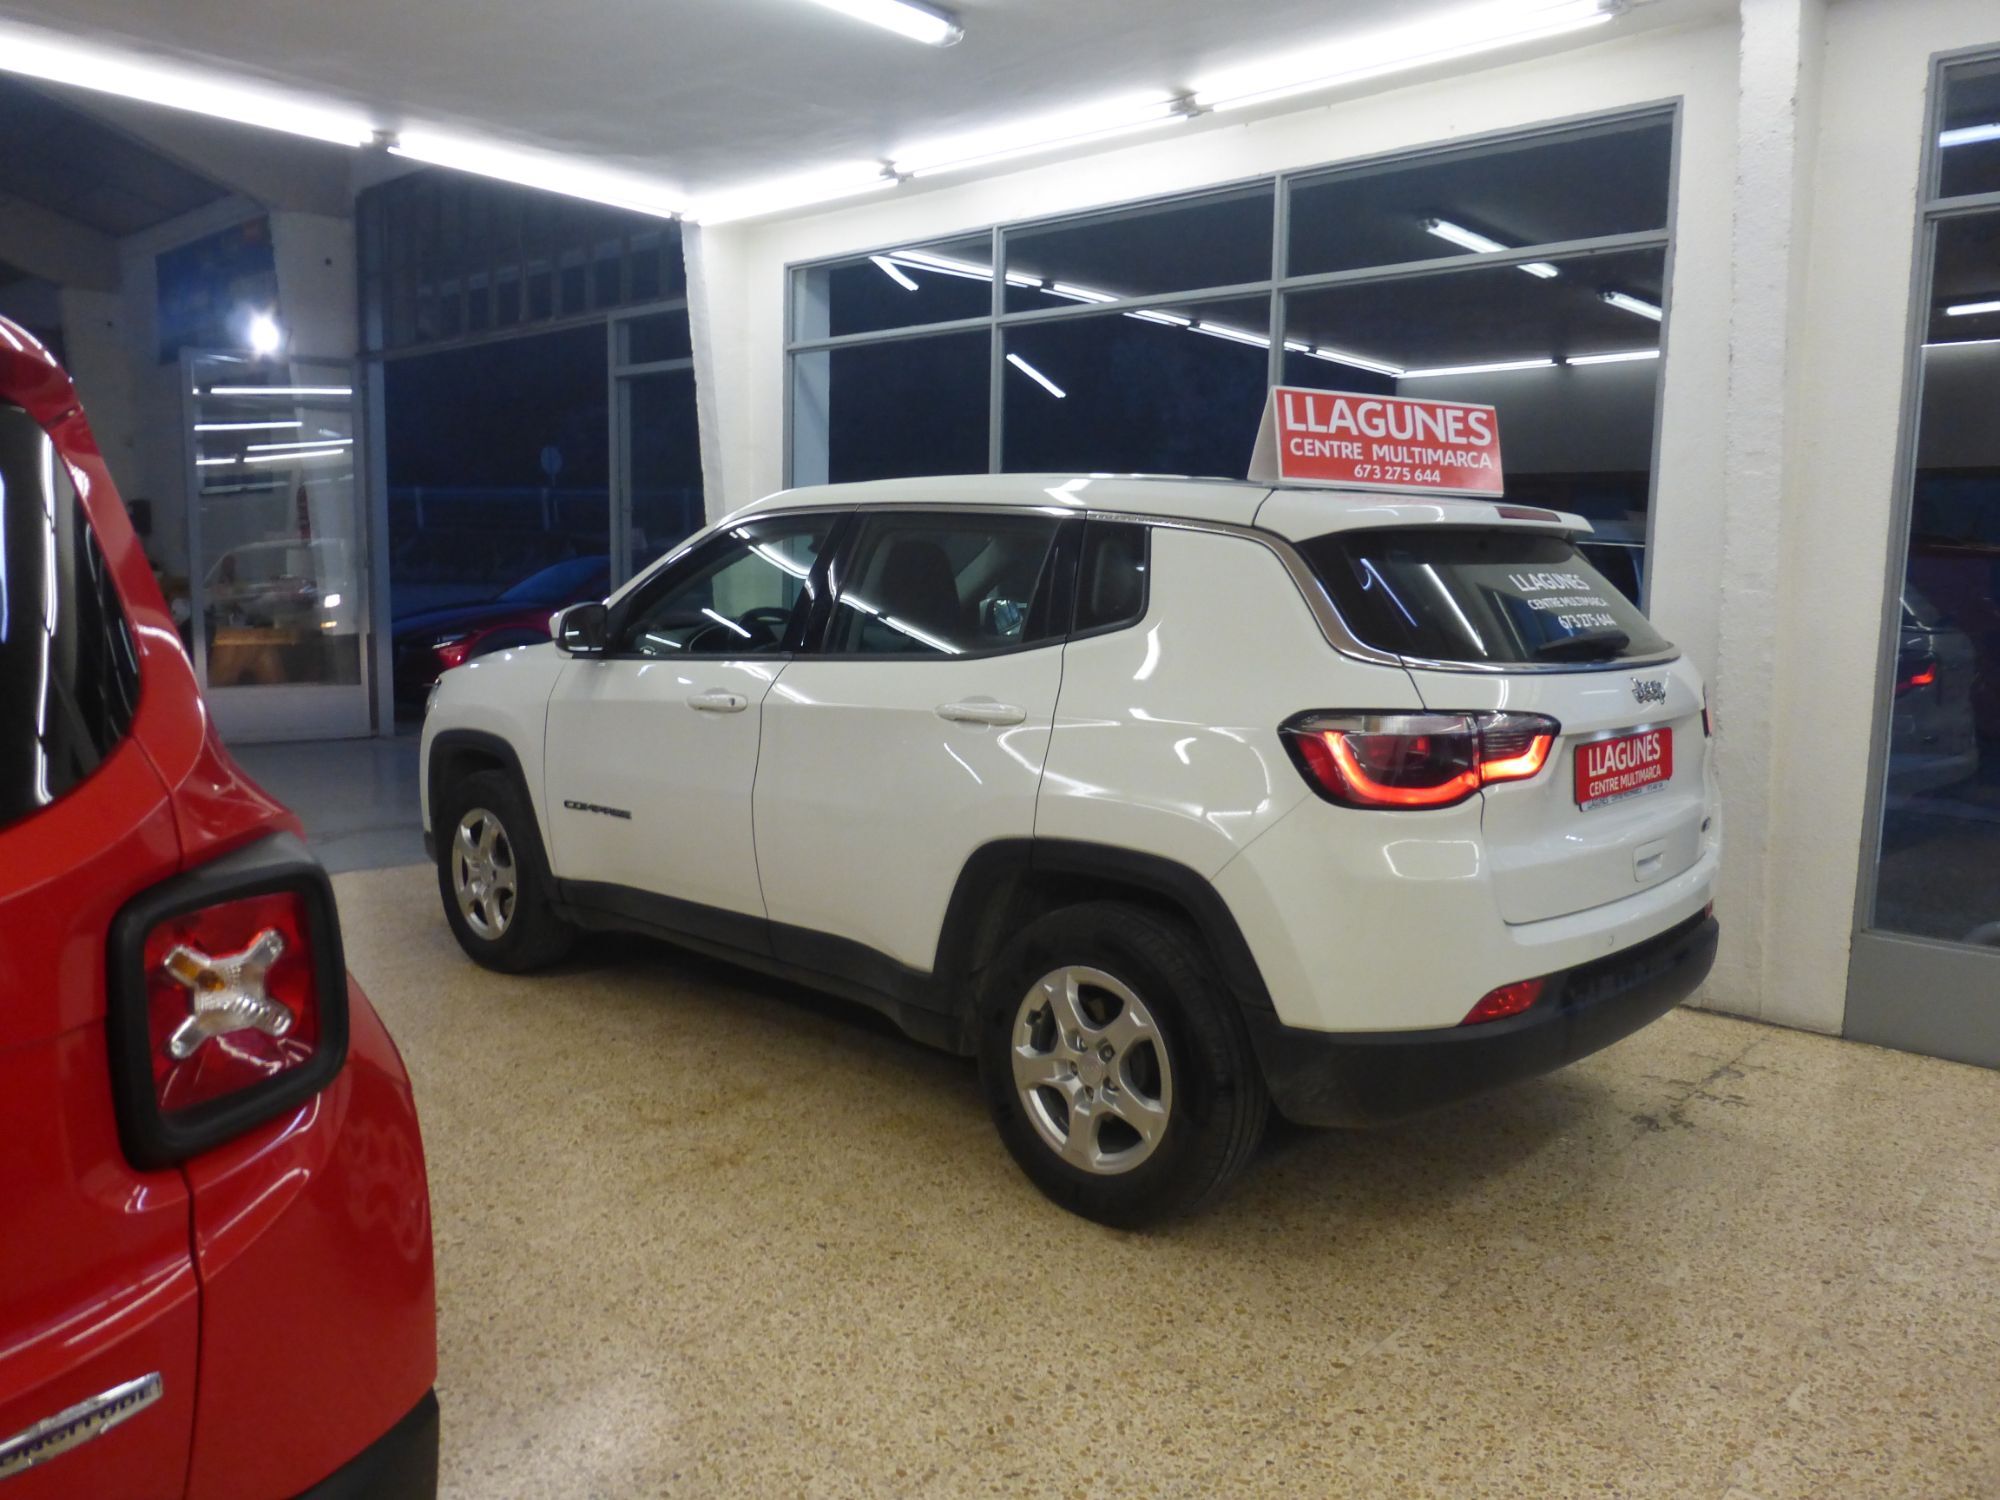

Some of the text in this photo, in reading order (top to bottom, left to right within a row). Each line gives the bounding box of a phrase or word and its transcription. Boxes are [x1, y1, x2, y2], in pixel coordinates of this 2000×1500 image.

[1284, 393, 1492, 446] LLAGUNES
[1290, 437, 1492, 469] CENTRE MULTIMARCA
[1354, 464, 1441, 483] 673 275 644
[1508, 572, 1591, 591] LLAGUNES
[1527, 597, 1564, 610] CENTRE
[1558, 614, 1580, 630] 673
[1588, 732, 1661, 777] LLAGUNES
[1589, 776, 1620, 797] CENTRE
[1619, 764, 1662, 789] MULTIMARCA
